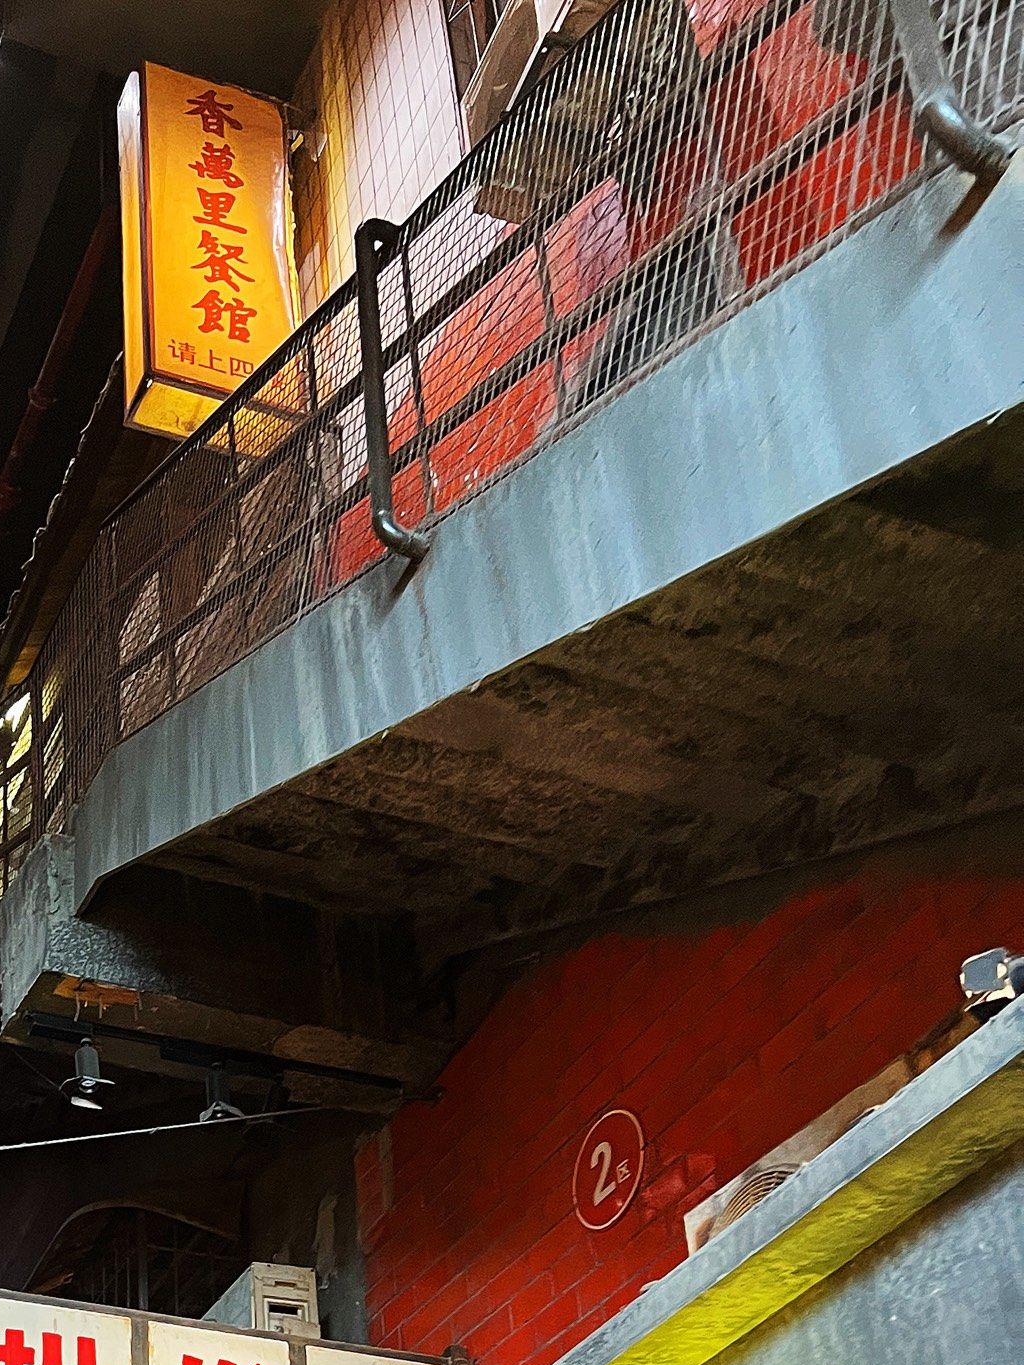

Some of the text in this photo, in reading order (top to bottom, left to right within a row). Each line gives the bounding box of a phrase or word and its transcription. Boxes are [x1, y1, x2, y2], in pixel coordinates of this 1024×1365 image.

[183, 90, 258, 343] 香萬里餐館
